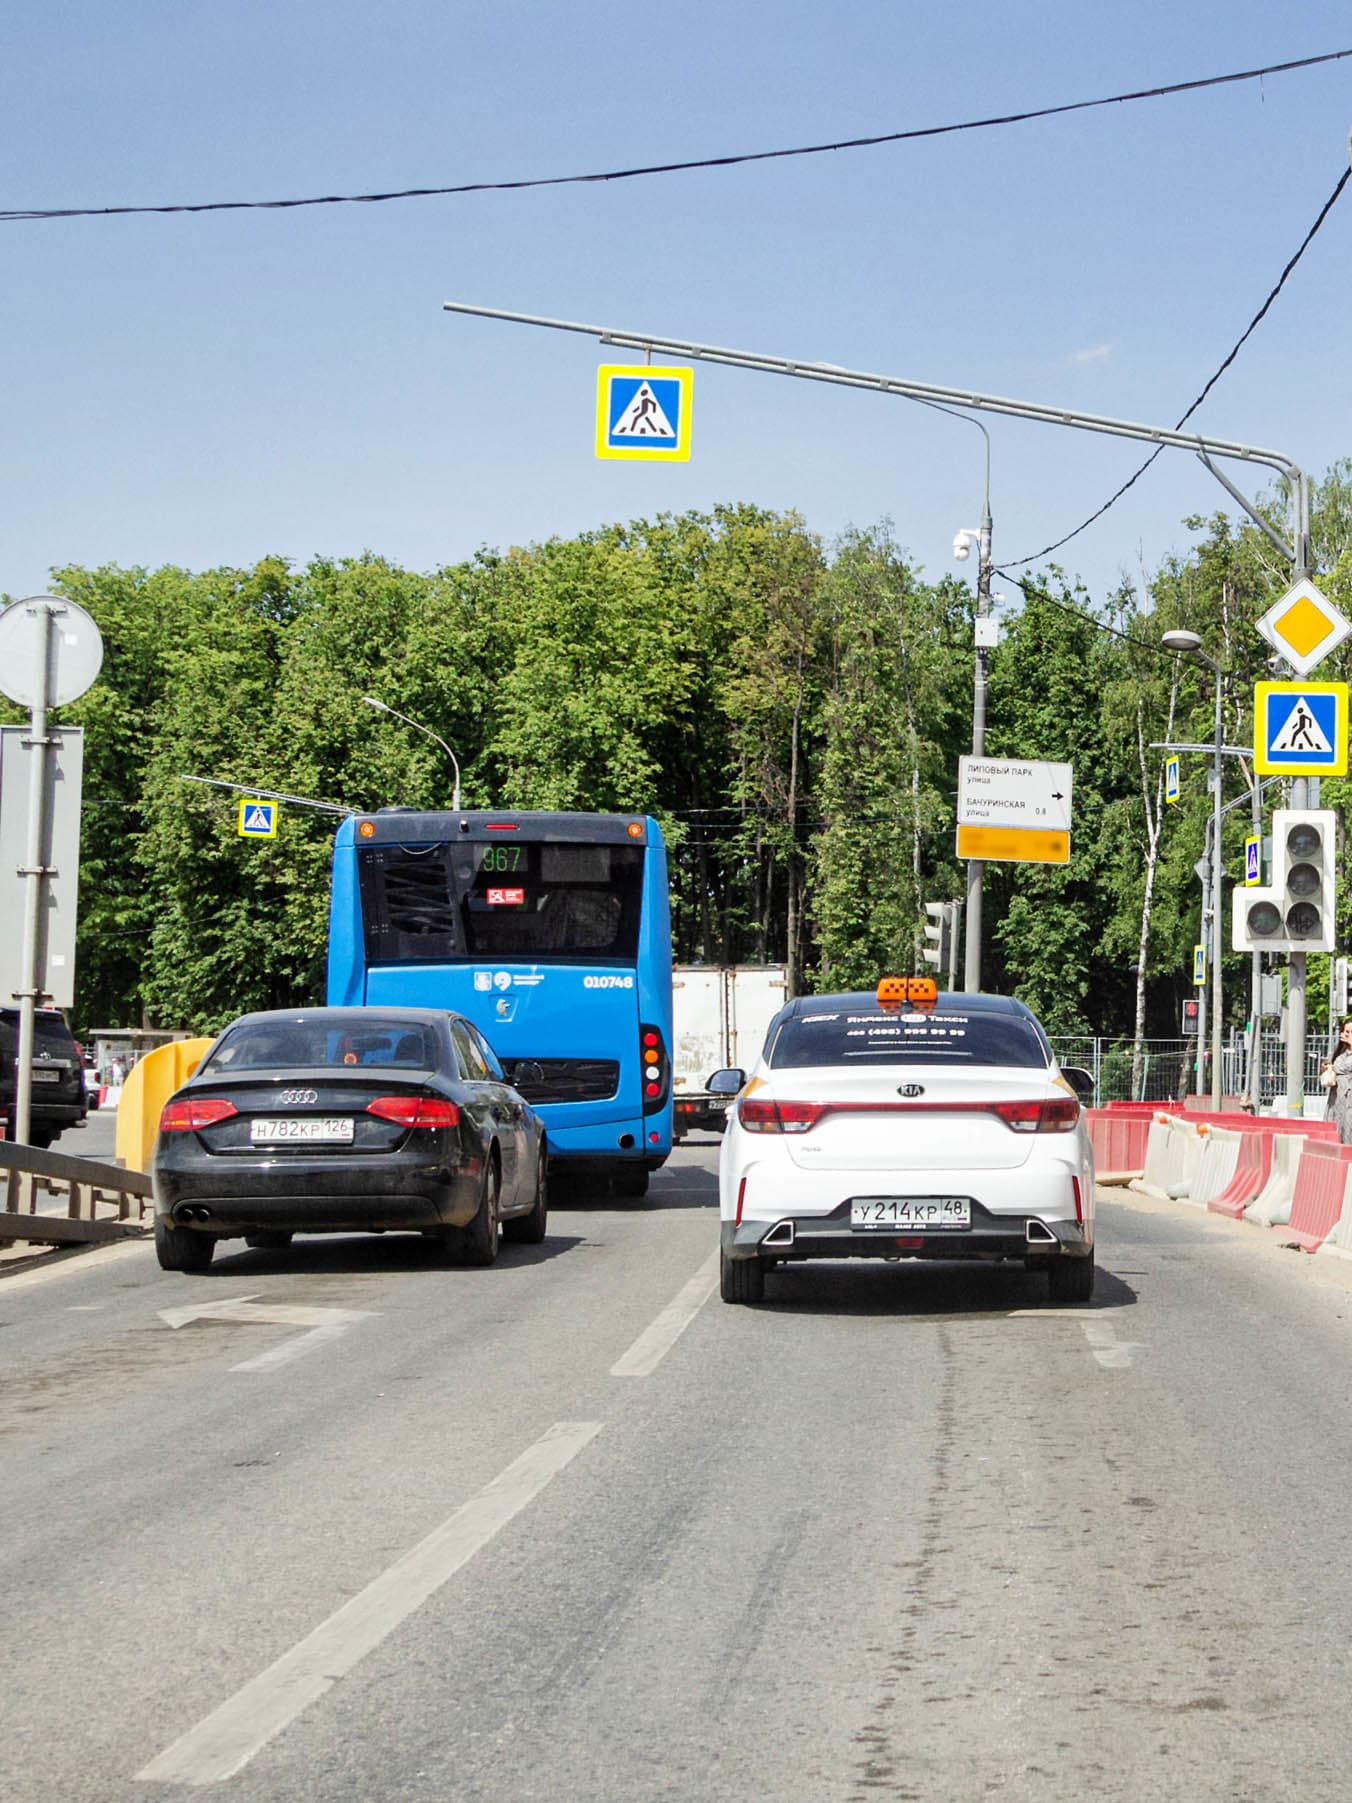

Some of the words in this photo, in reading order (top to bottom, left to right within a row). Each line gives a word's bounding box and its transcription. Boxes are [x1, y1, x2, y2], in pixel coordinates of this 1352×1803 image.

[1011, 767, 1033, 777] ПАРК
[966, 797, 1026, 809] БАЧУРИНСКАЯ
[483, 847, 521, 871] 967
[583, 975, 633, 989] 010748
[900, 1085, 921, 1096] KIA
[943, 1200, 962, 1215] 48
